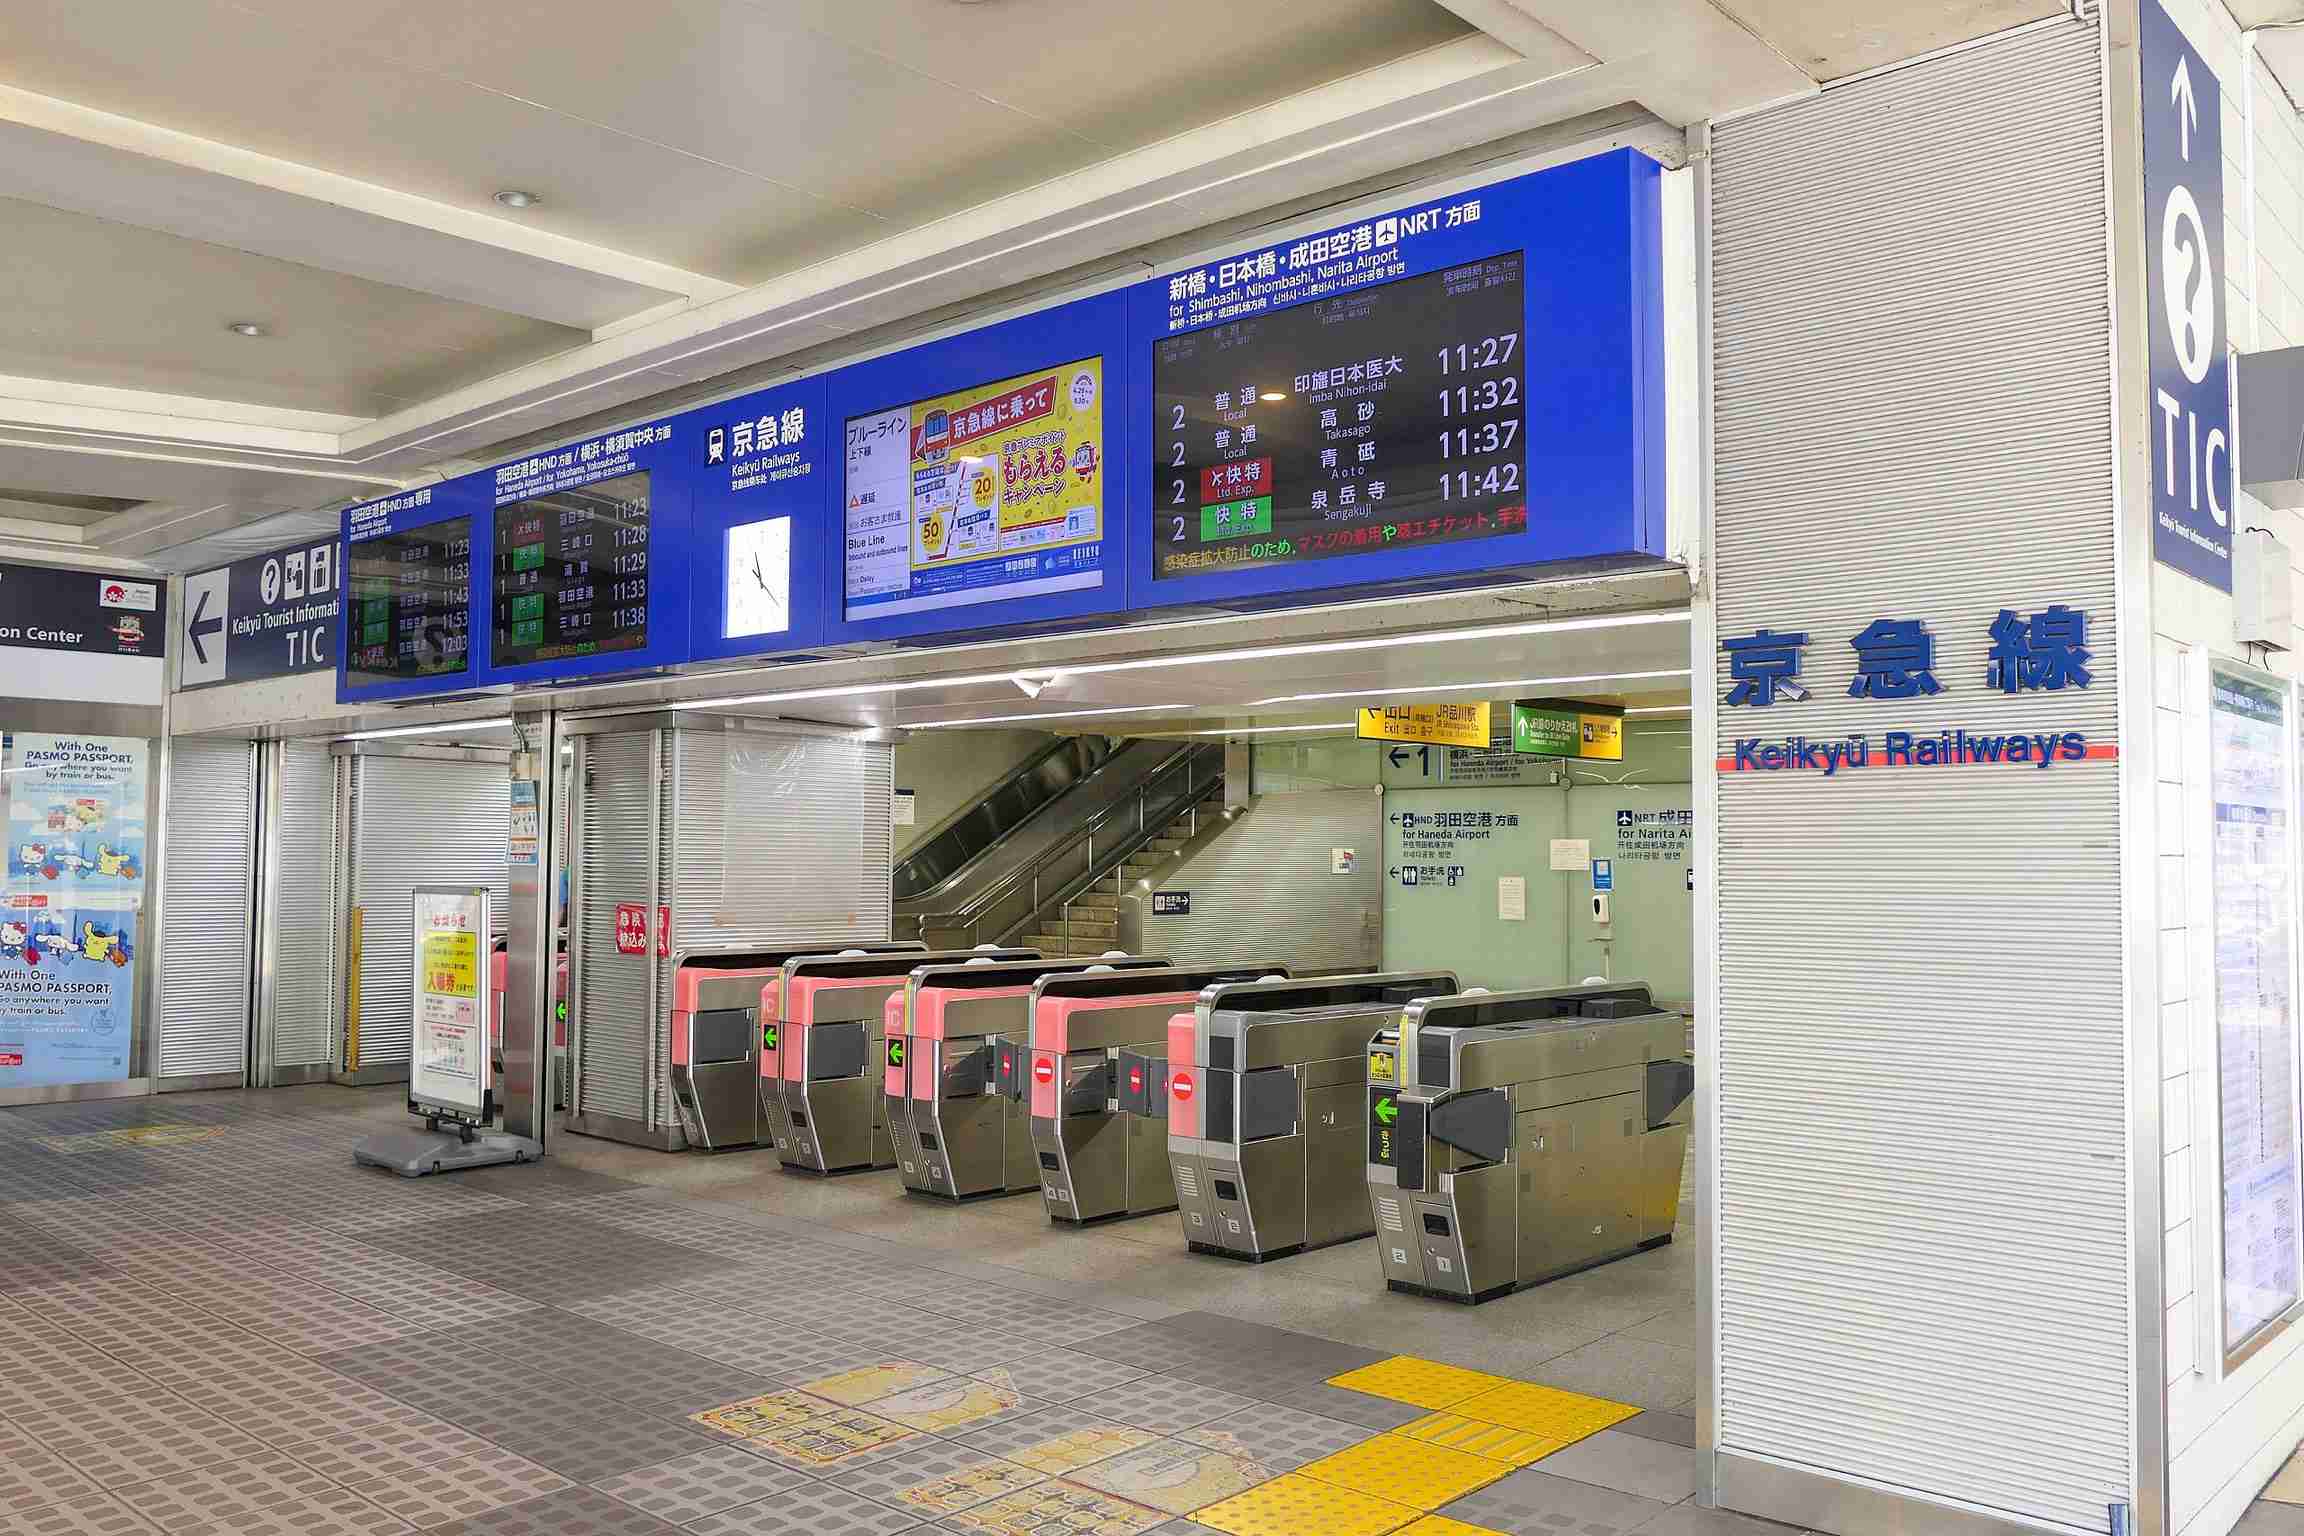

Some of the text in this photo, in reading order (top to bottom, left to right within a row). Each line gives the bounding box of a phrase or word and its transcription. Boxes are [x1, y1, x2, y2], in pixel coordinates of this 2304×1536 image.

[1169, 226, 1372, 302] 新橋・日本橋・成田空港
[1400, 208, 1441, 238] NRT
[1445, 200, 1480, 228] 方面
[1169, 248, 1398, 318] for Shimbashi, Nihombashi, Narita Airport
[1438, 333, 1518, 375] 11:27
[1215, 385, 1257, 411] 普通
[1438, 376, 1519, 417] 11:32
[953, 387, 1048, 440] 京急線に乗って
[1172, 404, 1185, 431] 2
[1320, 400, 1375, 428] 高砂
[732, 407, 804, 456] 京急線
[848, 416, 907, 446] ブルーライン
[1215, 424, 1257, 450] 普通
[1326, 424, 1371, 441] Takasago
[1438, 420, 1519, 459] 11:37
[539, 455, 556, 471] HND
[655, 425, 672, 441] 方面
[1172, 441, 1185, 467] 2
[1320, 441, 1376, 470] 青砥
[2157, 386, 2227, 527] TIC
[732, 451, 800, 477] Keikyū Railways
[1003, 446, 1066, 488] もらえる
[1226, 462, 1262, 484] 快特
[975, 478, 991, 494] 20
[1002, 480, 1066, 507] キャンペーン
[1172, 479, 1185, 504] 2
[1311, 480, 1387, 509] 泉岳寺
[1439, 463, 1519, 501] 11:42
[614, 496, 647, 522] 11:23
[1216, 502, 1257, 524] 快特
[1324, 504, 1372, 521] Sengakuji
[923, 522, 939, 538] 50
[1172, 516, 1185, 542] 2
[848, 536, 885, 550] Blue Line
[613, 552, 646, 575] 11:29
[613, 579, 646, 602] 11:33
[232, 614, 261, 637] Keikyū
[263, 608, 293, 629] Tourist
[443, 611, 469, 633] 11:53
[612, 606, 646, 629] 11:38
[27, 627, 83, 643] Center
[286, 626, 325, 666] TIC
[443, 634, 469, 653] 12:03
[1722, 605, 2092, 706] 京急線
[1385, 722, 1399, 733] Exit
[26, 751, 133, 763] PASMO PASSPORT,
[55, 741, 109, 752] With One
[1735, 729, 2087, 775] Keikyū Railways
[90, 765, 107, 773] you
[1417, 746, 1428, 776] 1
[46, 770, 57, 779] by
[60, 771, 81, 779] train
[1414, 812, 1519, 827] HND 羽田空港 方面
[1634, 814, 1656, 822] NRT
[1403, 830, 1490, 840] for Haneda Airport
[1618, 828, 1634, 838] for
[1639, 828, 1674, 838] Narita
[30, 970, 56, 980] One
[13, 995, 59, 1004] anywhere
[64, 997, 81, 1007] you
[46, 983, 112, 995] PASSPORT,
[10, 1006, 32, 1014] train
